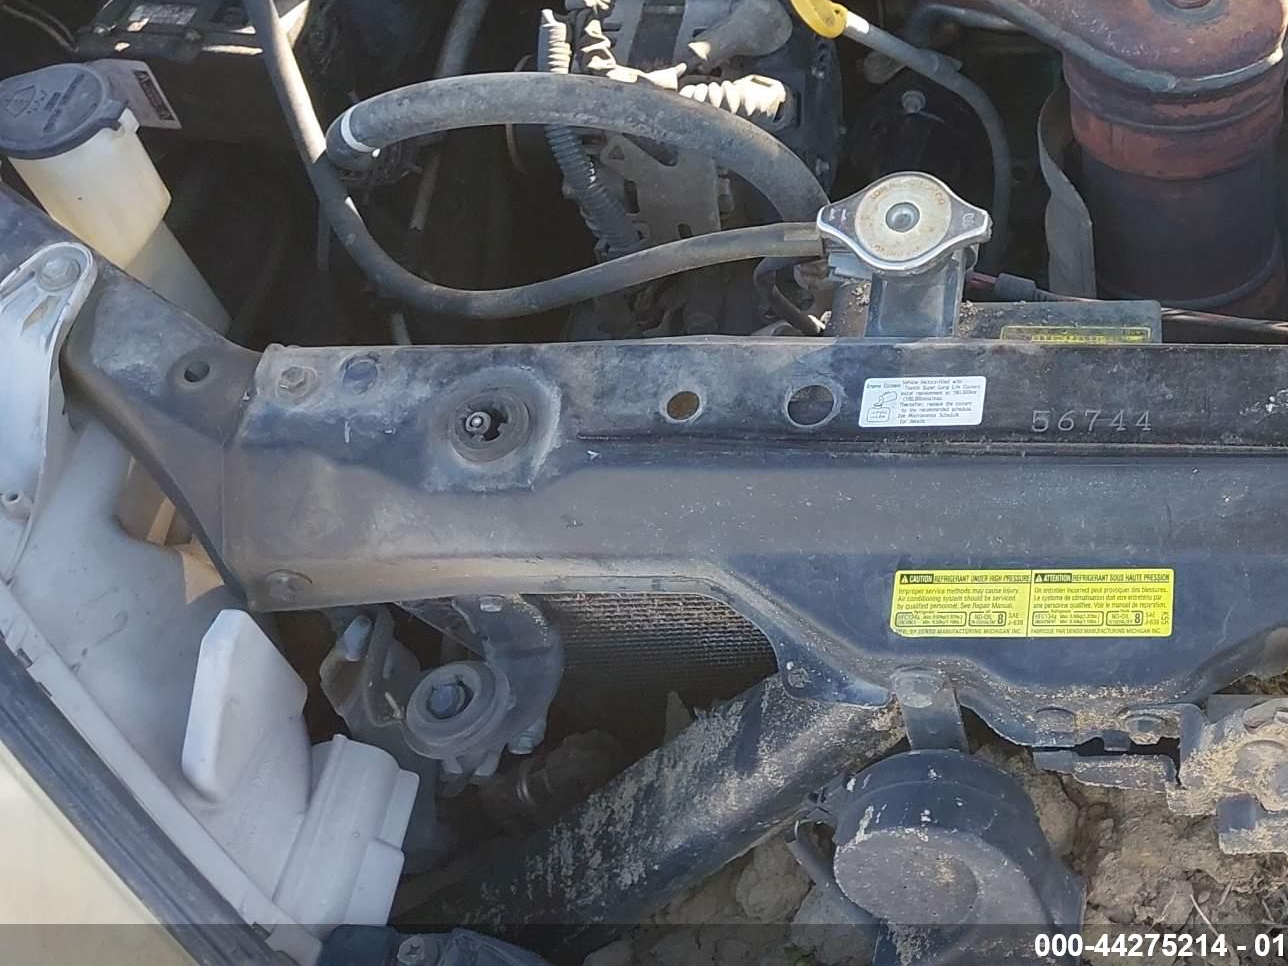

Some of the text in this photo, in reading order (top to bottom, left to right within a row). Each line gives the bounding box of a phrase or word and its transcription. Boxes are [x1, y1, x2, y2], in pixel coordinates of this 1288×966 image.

[1031, 409, 1151, 432] 56744
[909, 574, 1030, 583] CAUTION REFRIGERANT UNDER HIGH PRESSURE
[1043, 574, 1072, 582] ATTENTION
[1125, 573, 1143, 581] HAUTE
[1143, 573, 1170, 581] PRESSION
[997, 614, 1004, 624] 8
[1134, 613, 1141, 624] 8
